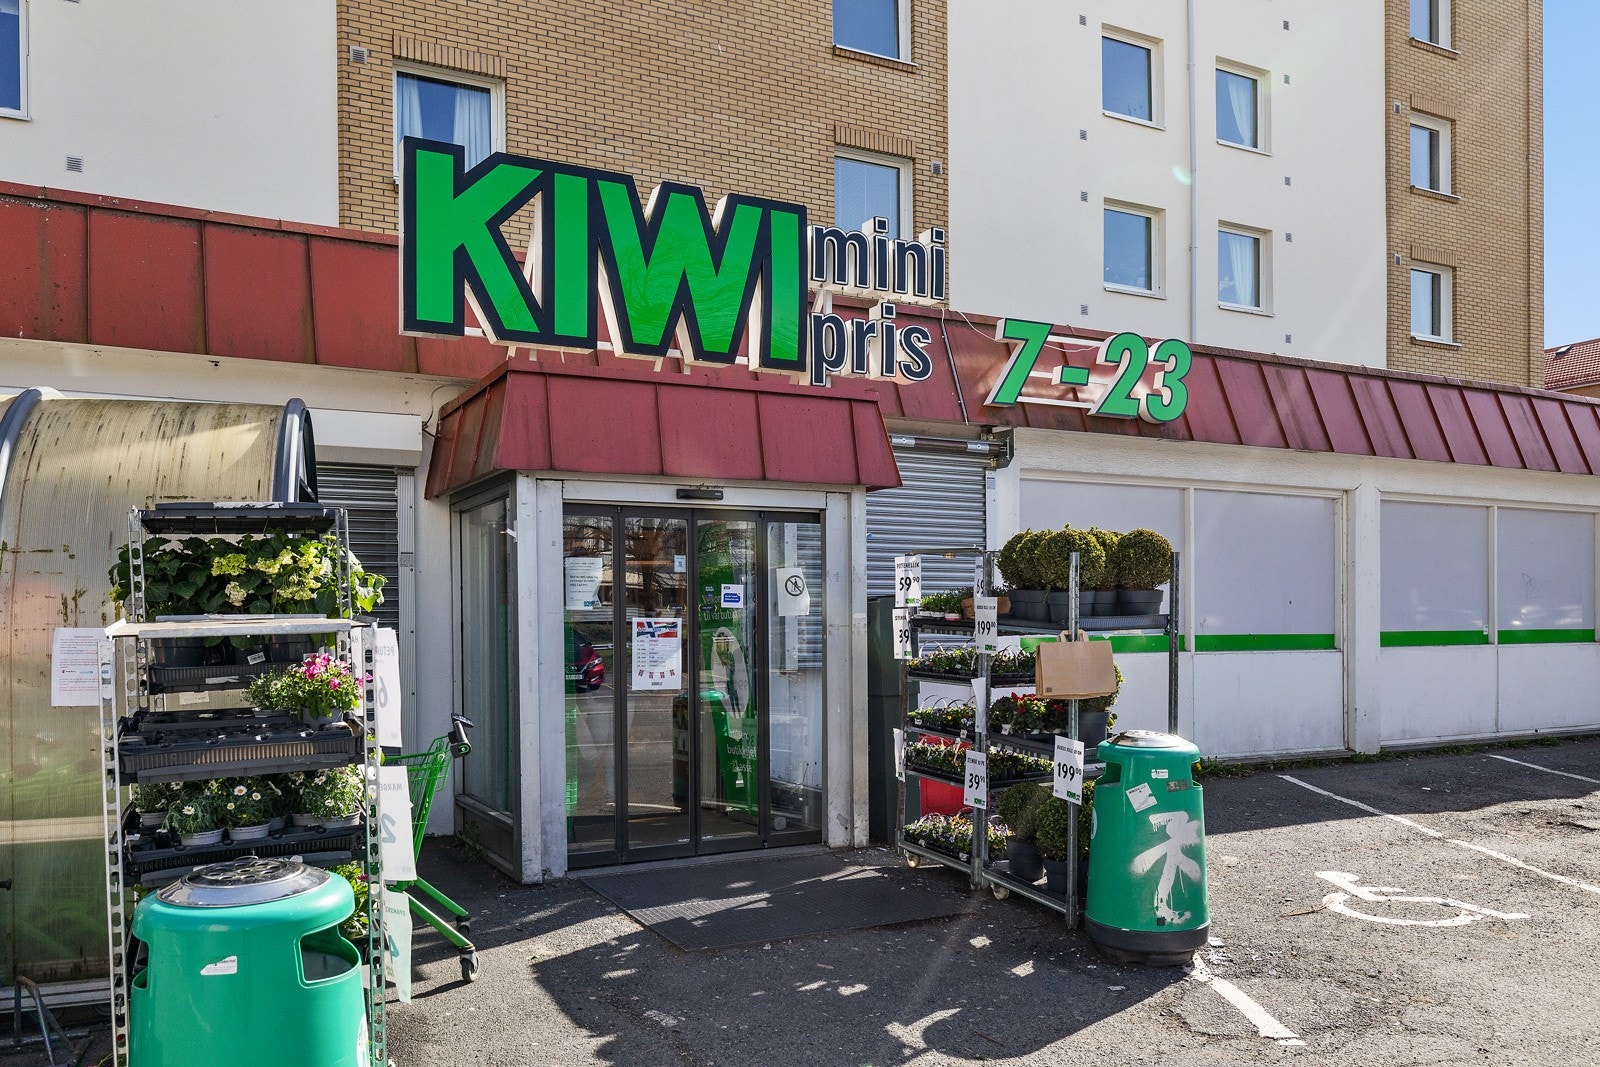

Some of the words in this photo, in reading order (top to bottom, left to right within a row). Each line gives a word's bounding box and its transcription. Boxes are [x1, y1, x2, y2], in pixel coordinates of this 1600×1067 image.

[403, 136, 807, 372] KIWI
[811, 216, 946, 300] mini
[810, 302, 932, 387] pris
